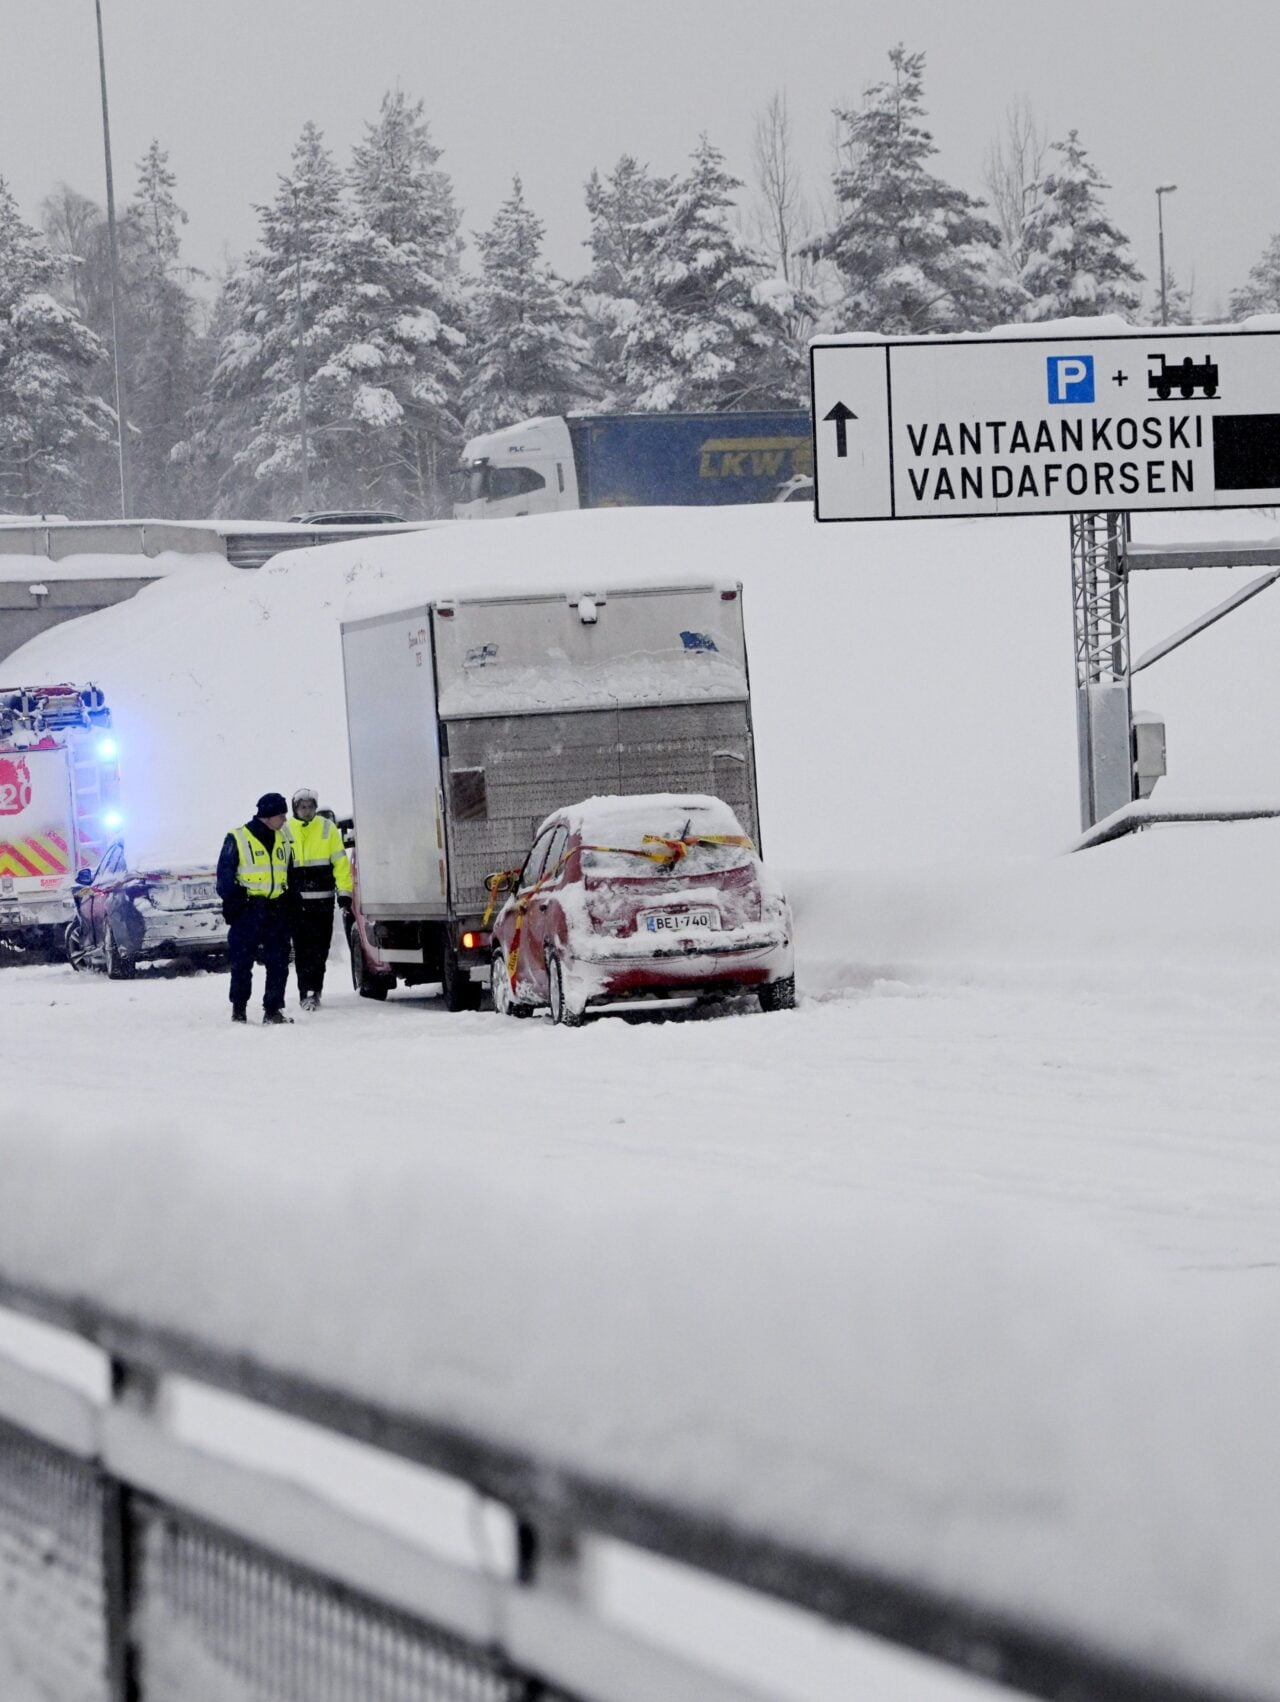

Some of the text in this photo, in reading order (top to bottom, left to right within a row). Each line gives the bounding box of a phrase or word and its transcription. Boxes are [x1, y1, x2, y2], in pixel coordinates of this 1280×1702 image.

[906, 415, 1203, 457] VANTAANKOSKI
[699, 451, 785, 478] LKW
[907, 459, 1194, 501] VANDAFORSEN
